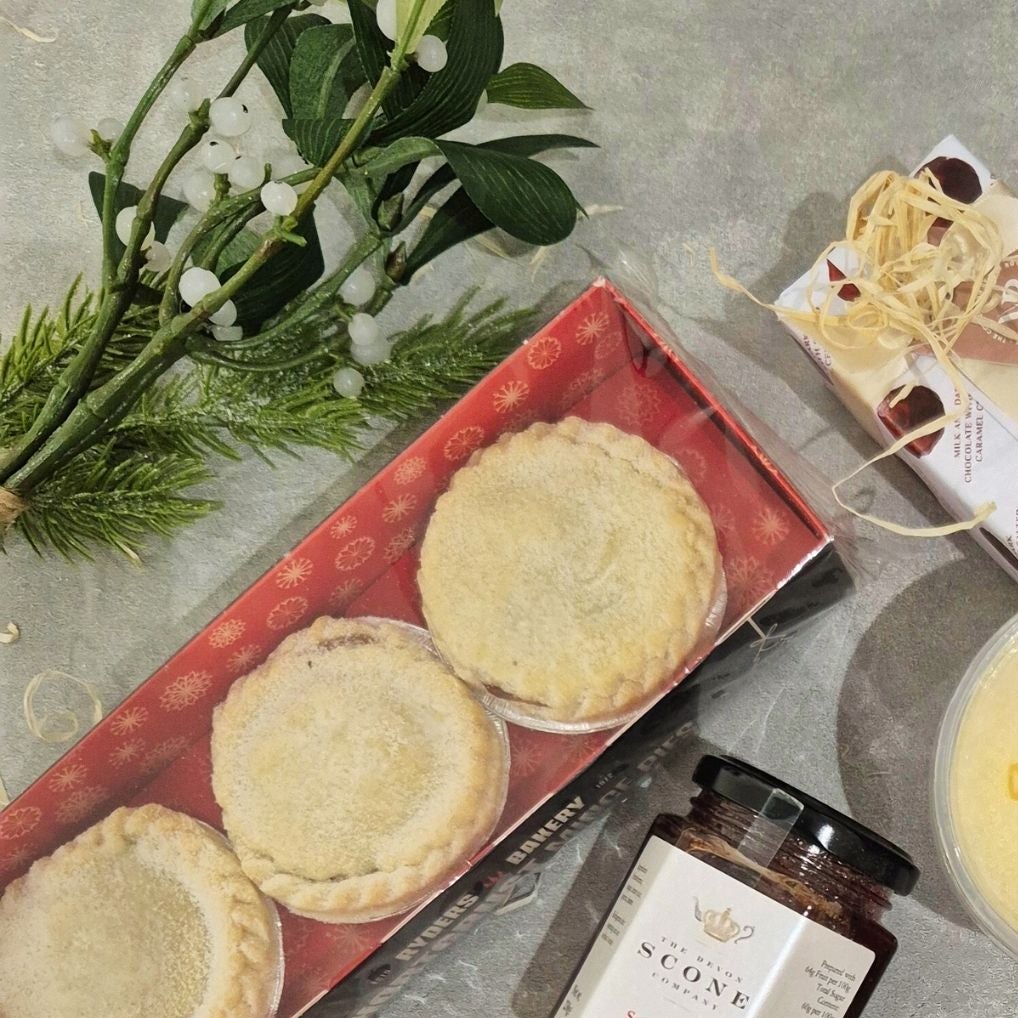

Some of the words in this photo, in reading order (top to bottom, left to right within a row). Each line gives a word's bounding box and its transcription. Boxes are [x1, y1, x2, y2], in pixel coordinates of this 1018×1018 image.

[951, 431, 962, 458] MILK
[962, 422, 975, 483] CHOCOLATE
[973, 414, 985, 462] CARAMEL
[395, 892, 480, 961] RYDERS
[504, 796, 587, 866] BAKERY
[638, 942, 749, 1009] SCONE
[661, 937, 686, 954] THE
[697, 955, 741, 983] DEVON
[652, 972, 716, 1010] COMPANY
